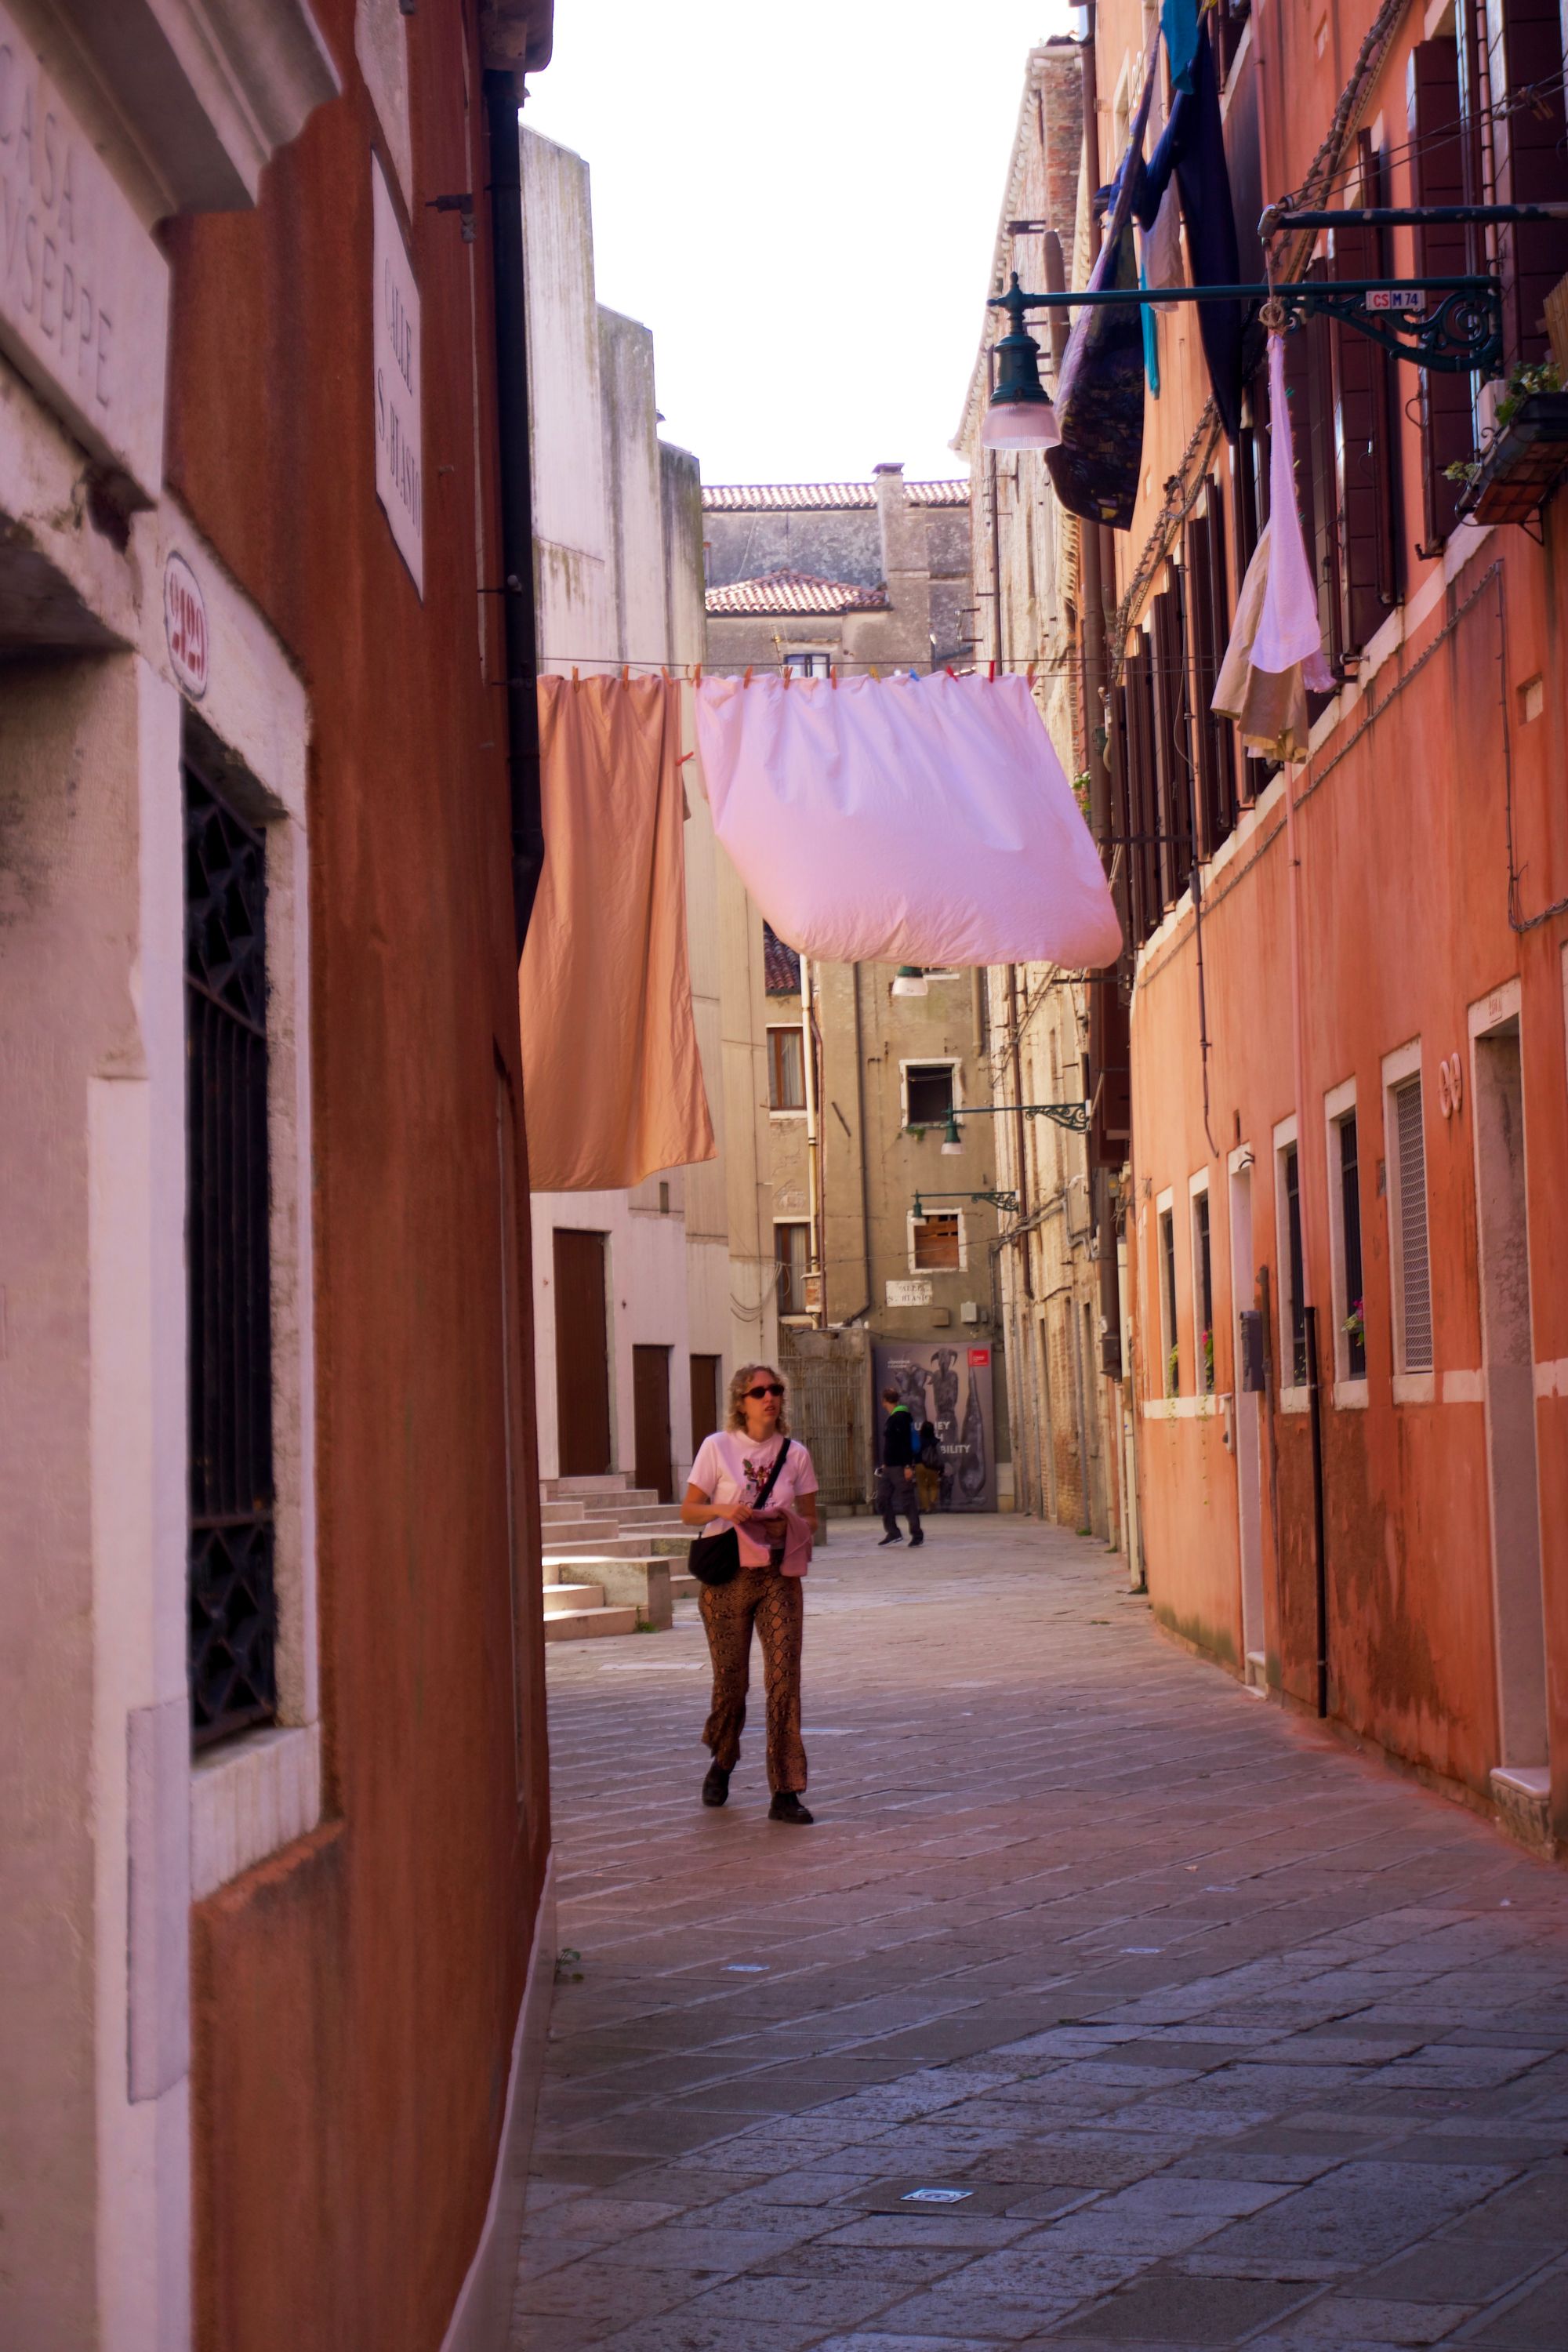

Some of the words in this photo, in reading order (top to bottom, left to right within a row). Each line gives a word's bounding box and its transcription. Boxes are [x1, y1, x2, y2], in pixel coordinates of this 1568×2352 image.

[384, 257, 412, 397] CALLE
[1373, 294, 1388, 307] CS
[1392, 293, 1402, 307] M
[1404, 292, 1418, 306] 74
[390, 400, 422, 539] BIASIO
